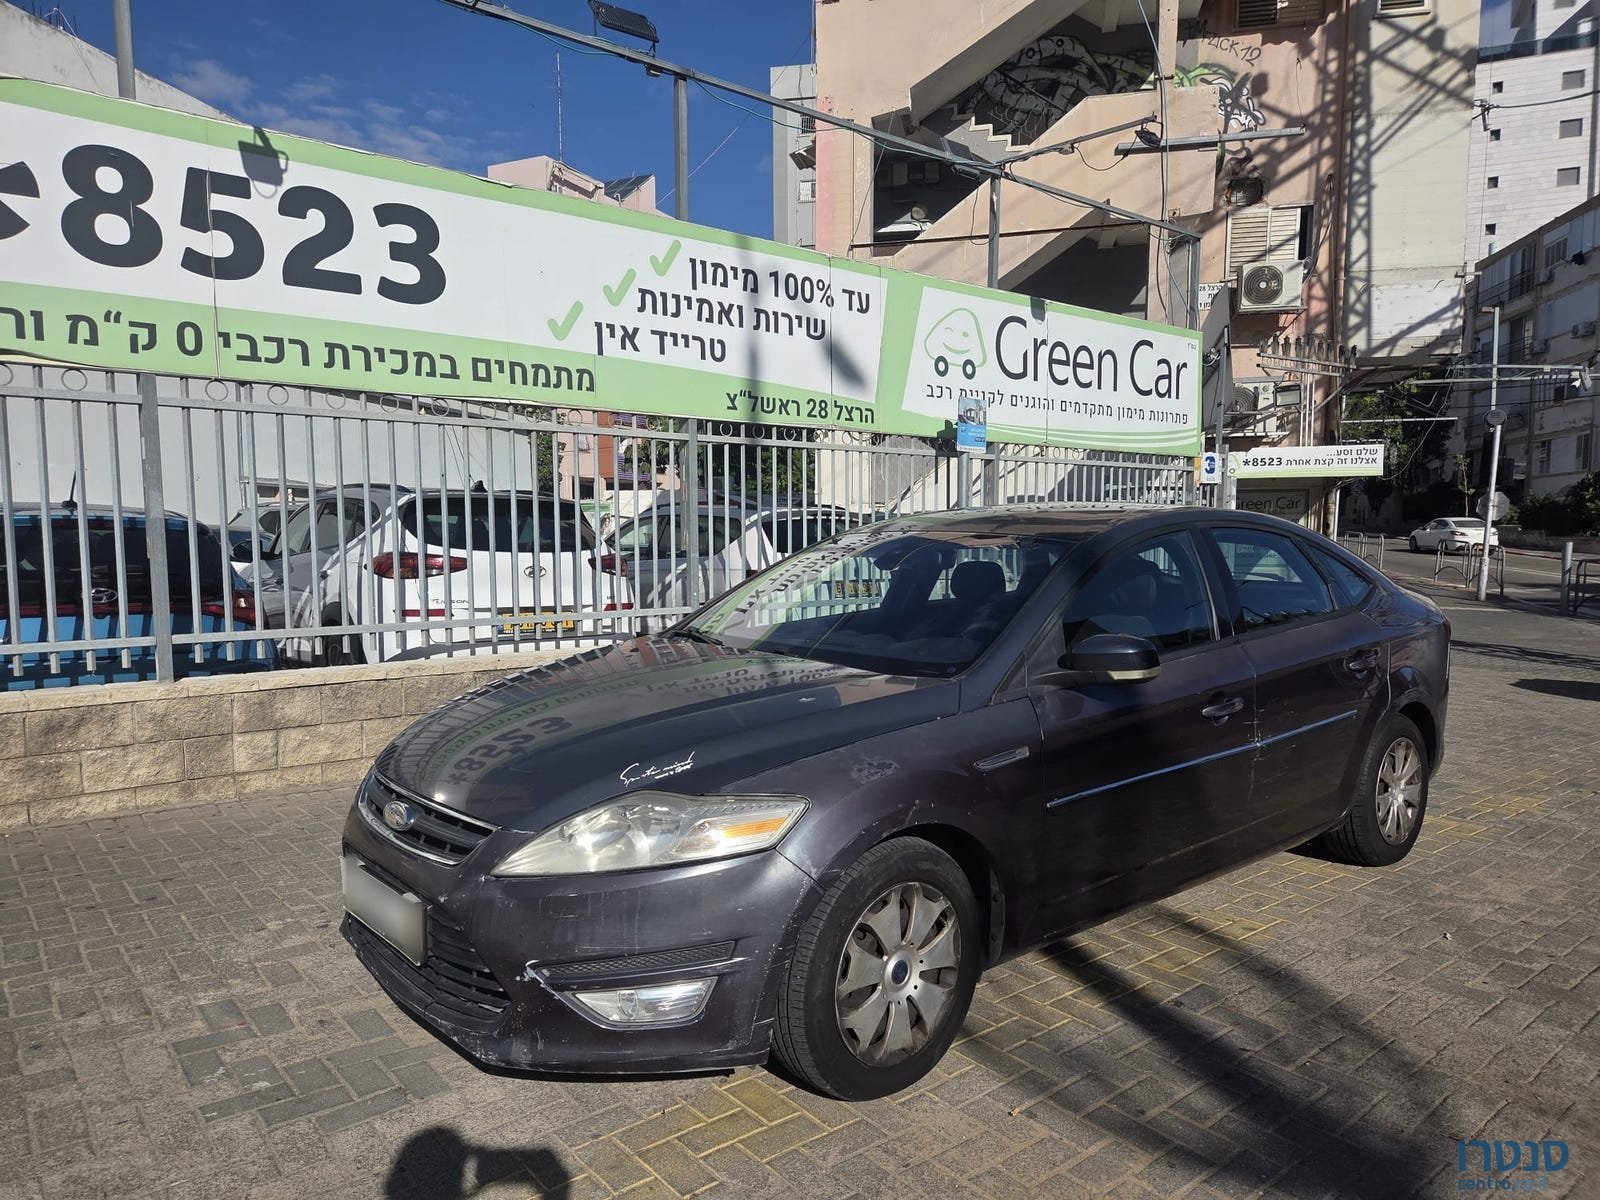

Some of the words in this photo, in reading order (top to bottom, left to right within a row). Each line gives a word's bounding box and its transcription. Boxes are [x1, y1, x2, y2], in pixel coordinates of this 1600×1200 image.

[689, 257, 759, 294] מימון
[769, 270, 835, 308] 100%
[637, 287, 744, 328] ואמינות
[842, 288, 870, 315] עד
[752, 307, 826, 341] שירות
[176, 320, 203, 357] 0
[217, 331, 310, 367] רכבי
[594, 321, 640, 356] אין
[650, 329, 727, 363] טרייד
[324, 341, 461, 380] במכירת
[995, 315, 1118, 392] Green
[1129, 339, 1188, 400] Car
[472, 356, 595, 392] מתמחים
[926, 384, 952, 400] רכב
[1010, 394, 1055, 411] והוגנים
[806, 398, 829, 419] 28
[833, 400, 875, 424] הרצל
[1060, 400, 1113, 418] מתקדמים
[1117, 405, 1145, 421] מימון
[1149, 410, 1188, 424] פתרונות
[1313, 458, 1334, 467] קצת
[1336, 457, 1348, 465] זה
[1350, 456, 1378, 465] אצלנו
[1355, 447, 1378, 456] שלם
